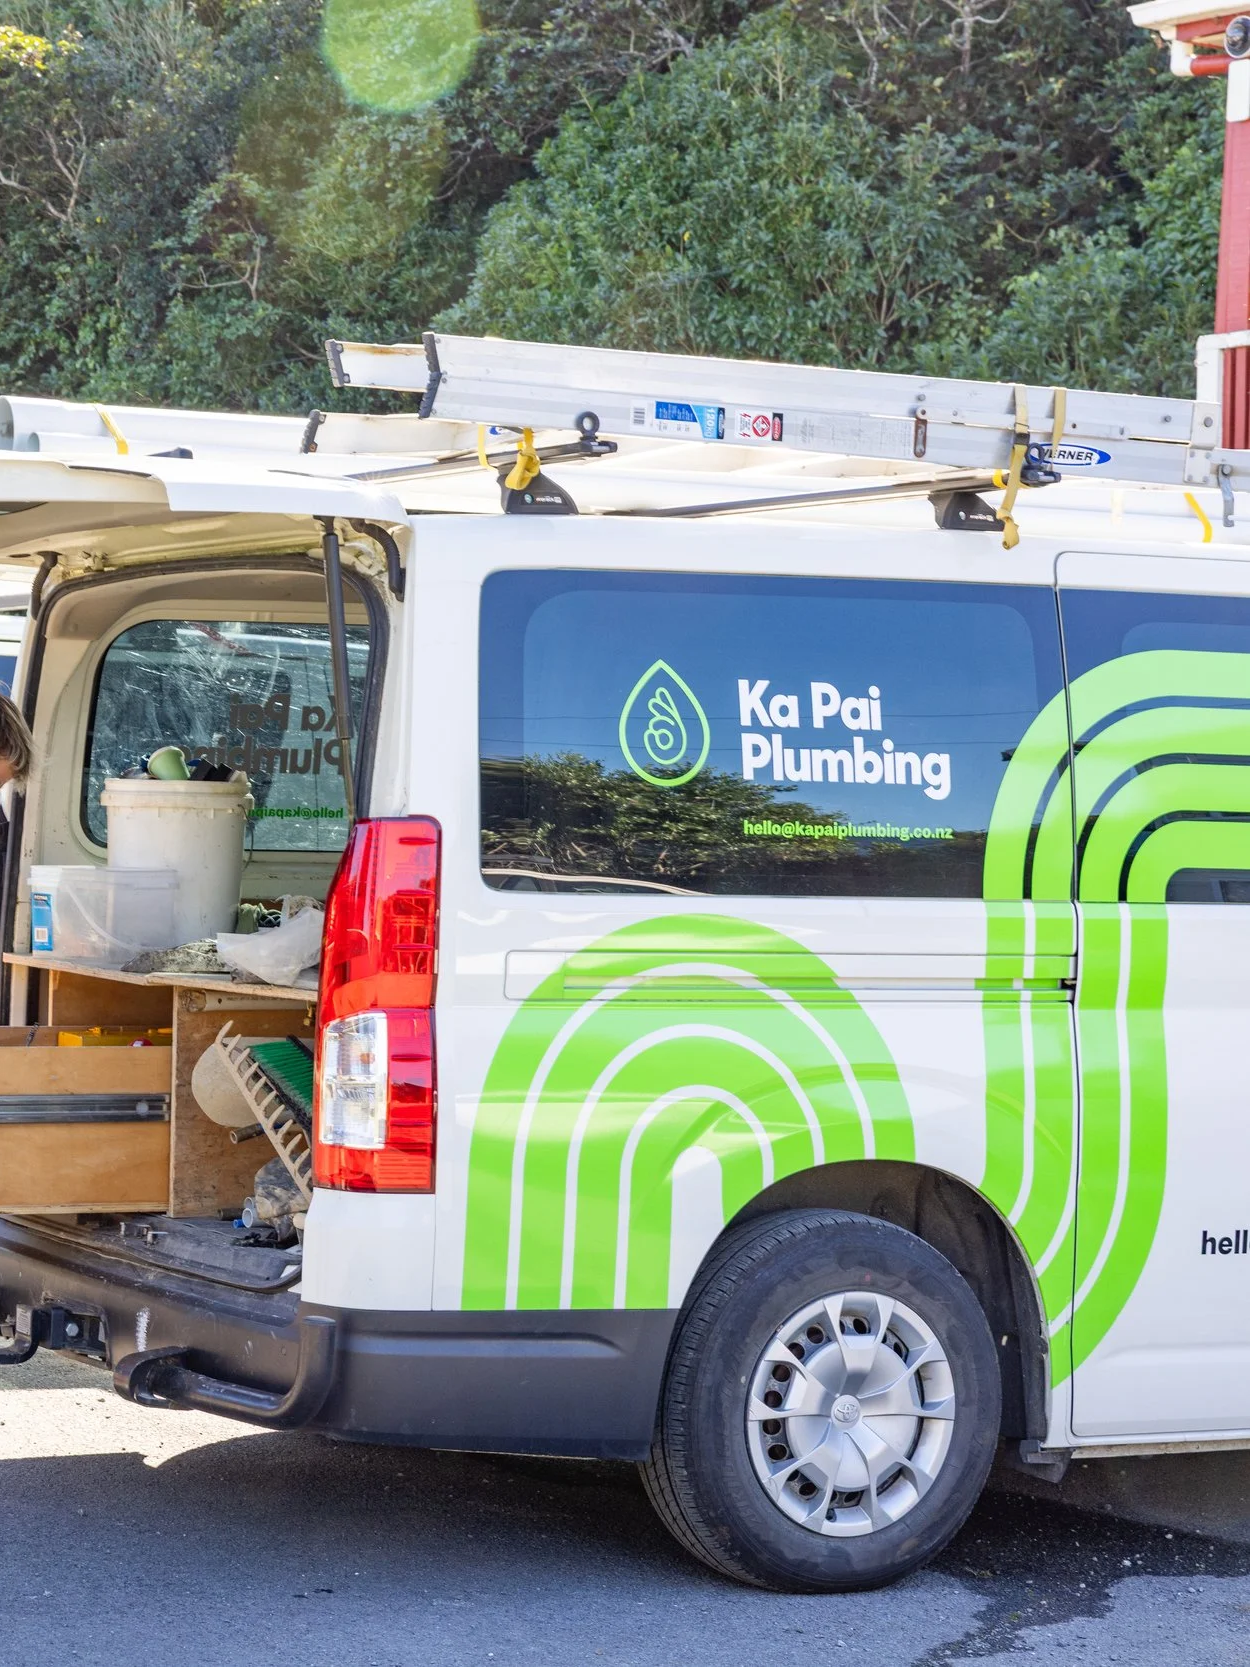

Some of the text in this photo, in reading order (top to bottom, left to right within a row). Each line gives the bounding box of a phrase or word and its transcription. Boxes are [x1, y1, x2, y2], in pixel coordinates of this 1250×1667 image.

[737, 679, 883, 731] Ka Pai
[741, 733, 952, 800] Plumbing
[743, 820, 953, 842] hello@kapaiplumbing.co.nz
[1201, 1229, 1250, 1255] hell
